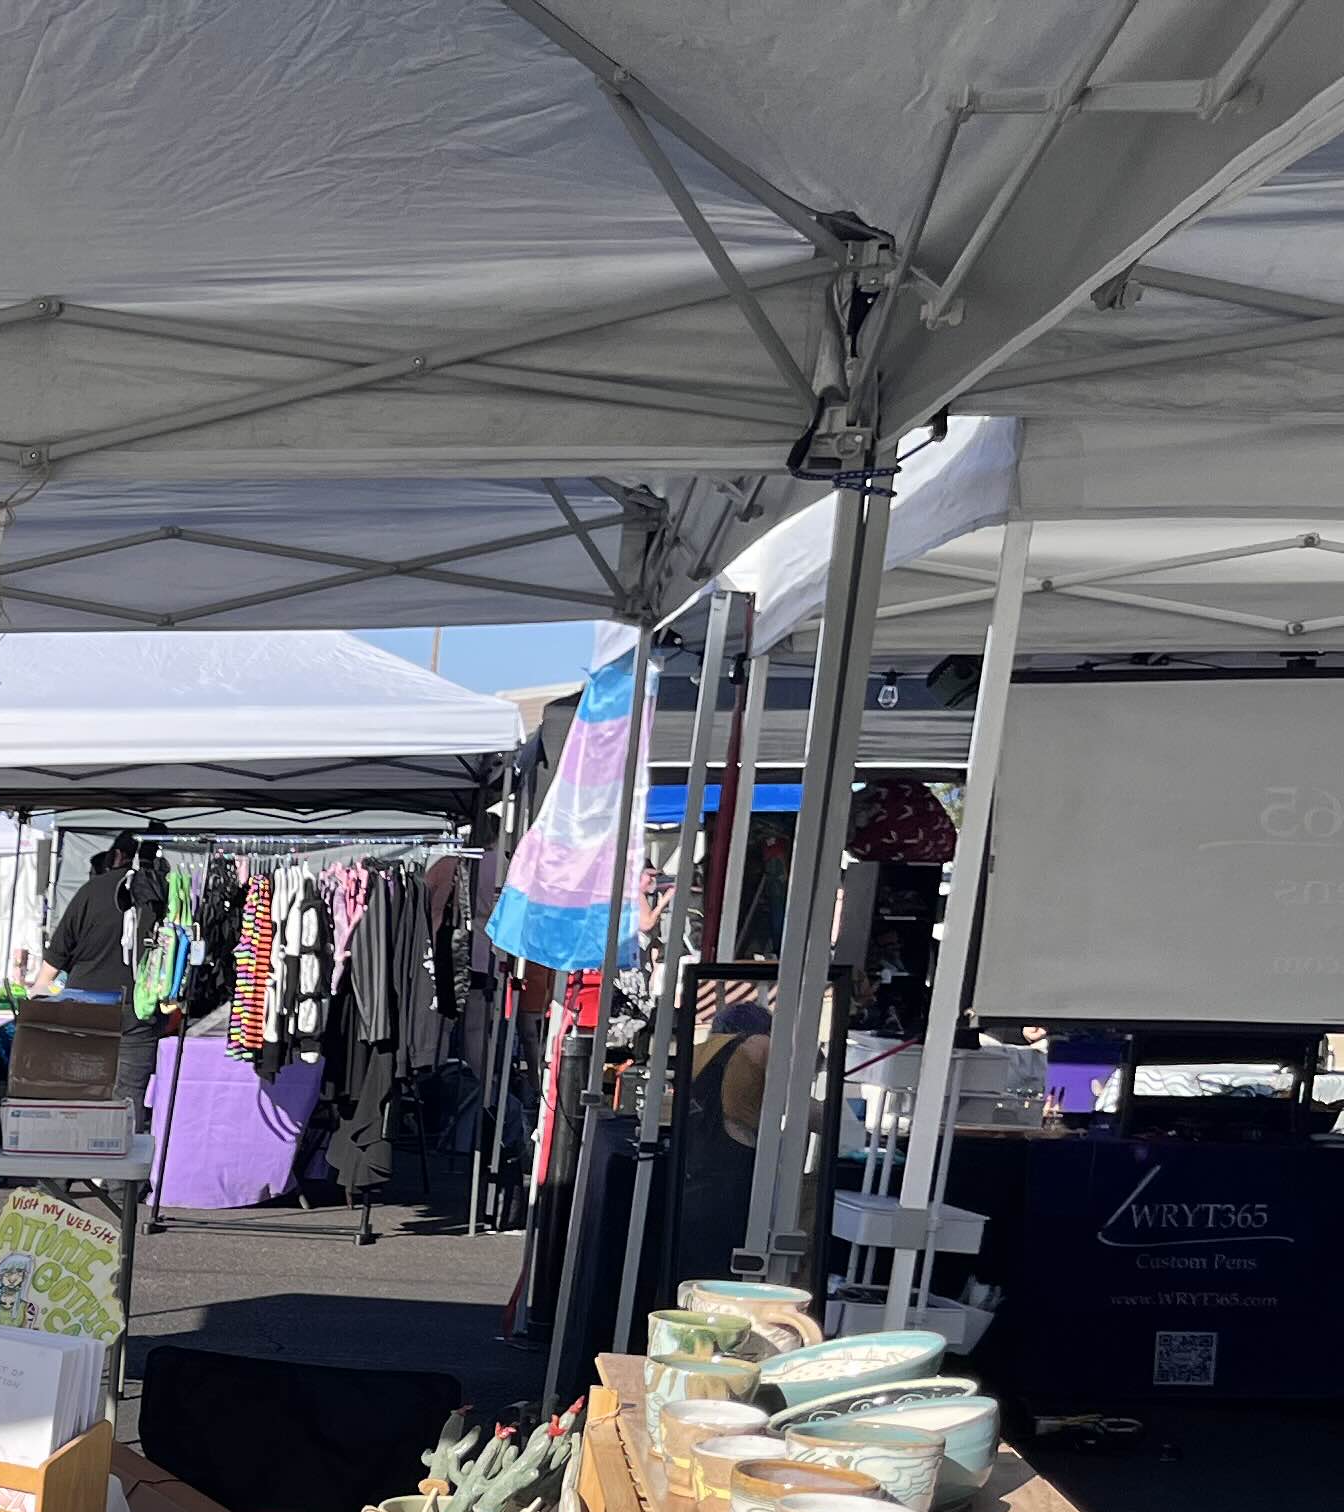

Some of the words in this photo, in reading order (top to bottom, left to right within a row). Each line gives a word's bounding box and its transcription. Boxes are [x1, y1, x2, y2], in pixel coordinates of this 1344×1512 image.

[1131, 1202, 1270, 1230] WRYT365
[1135, 1254, 1209, 1271] Custom
[1213, 1253, 1258, 1271] Pens
